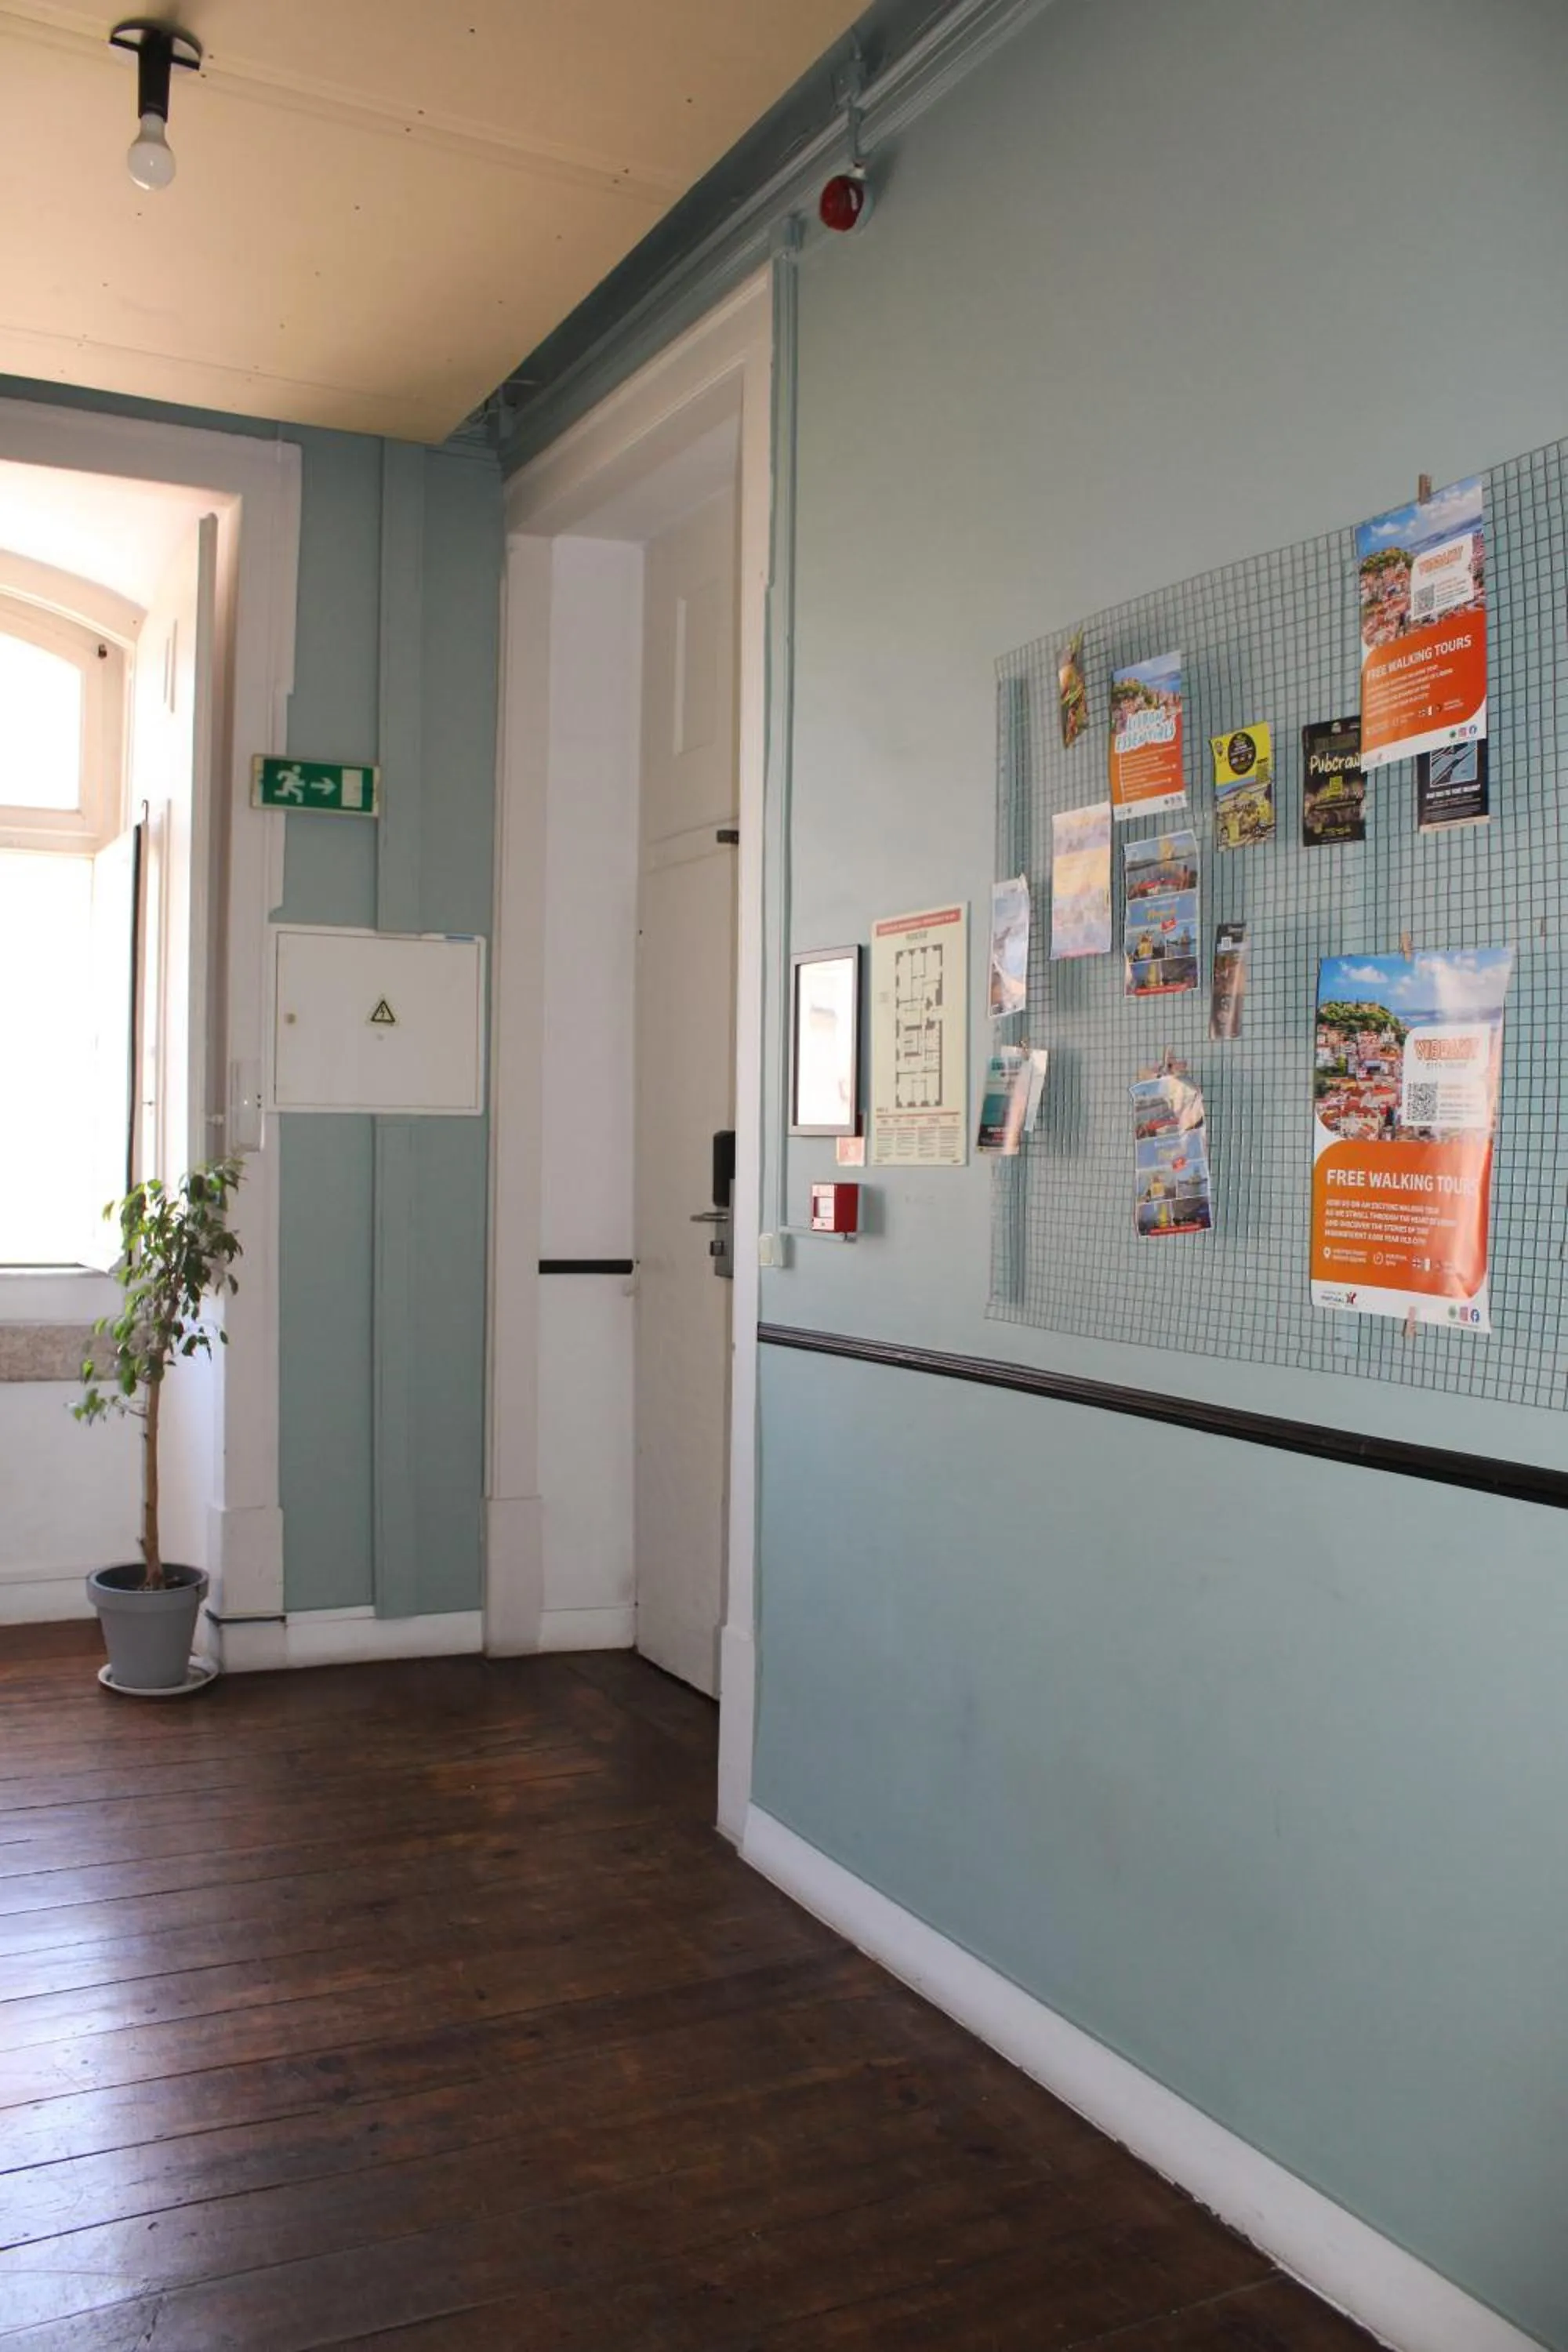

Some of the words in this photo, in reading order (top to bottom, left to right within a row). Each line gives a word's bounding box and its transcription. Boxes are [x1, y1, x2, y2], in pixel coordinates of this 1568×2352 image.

[1389, 647, 1432, 672] WALKING
[1435, 634, 1472, 657] TOURS
[1310, 752, 1362, 776] Pubcraw
[1327, 1169, 1366, 1186] FREE
[1369, 1171, 1434, 1192] WALKING
